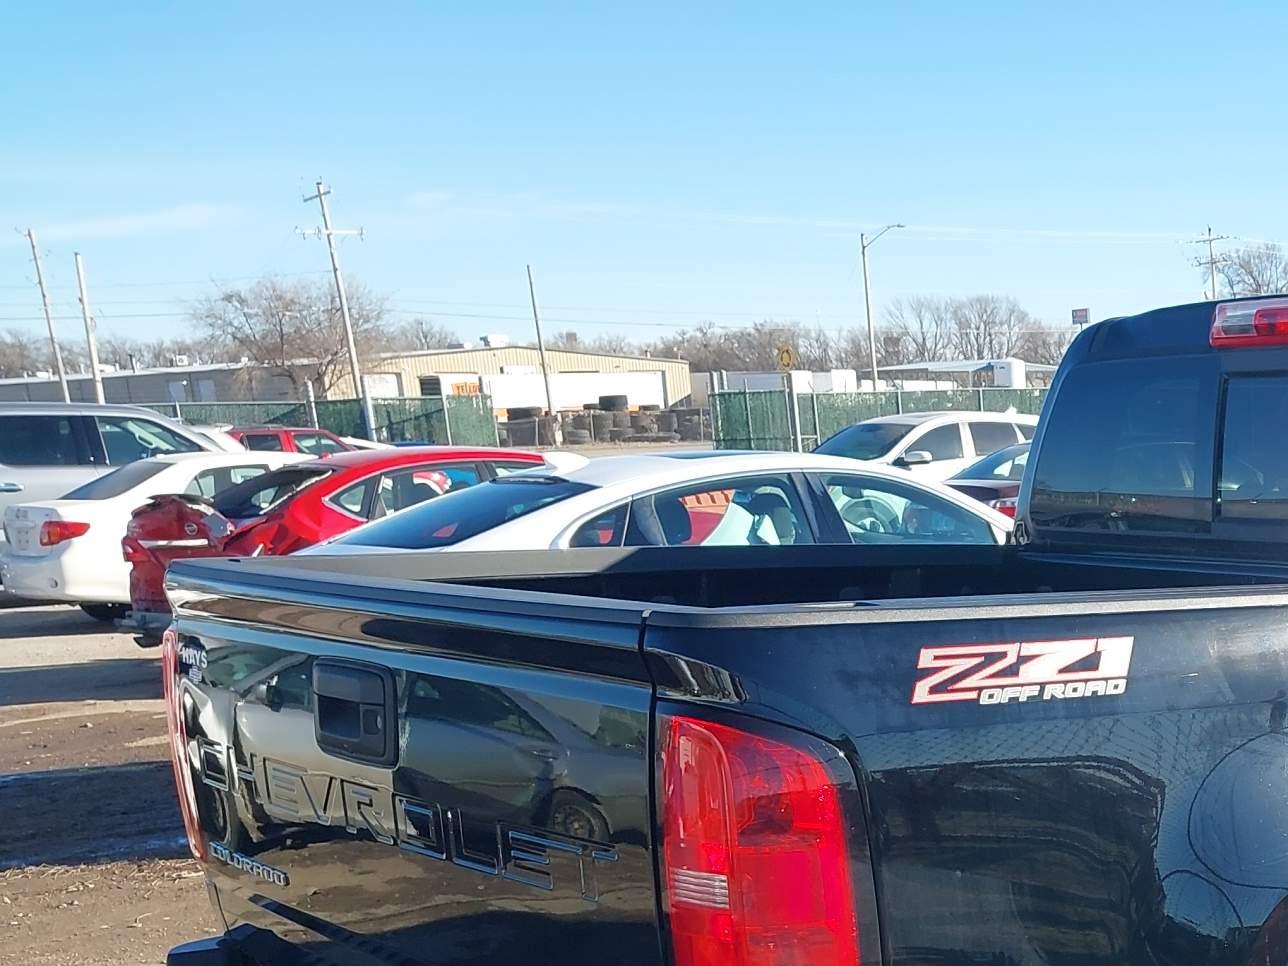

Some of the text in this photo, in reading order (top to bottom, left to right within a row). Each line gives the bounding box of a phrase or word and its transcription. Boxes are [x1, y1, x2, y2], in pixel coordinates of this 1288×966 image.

[911, 636, 1134, 705] Z71
[979, 679, 1127, 705] OFF ROAD
[196, 736, 619, 901] CHEVROLET
[208, 841, 289, 887] COLORADO
